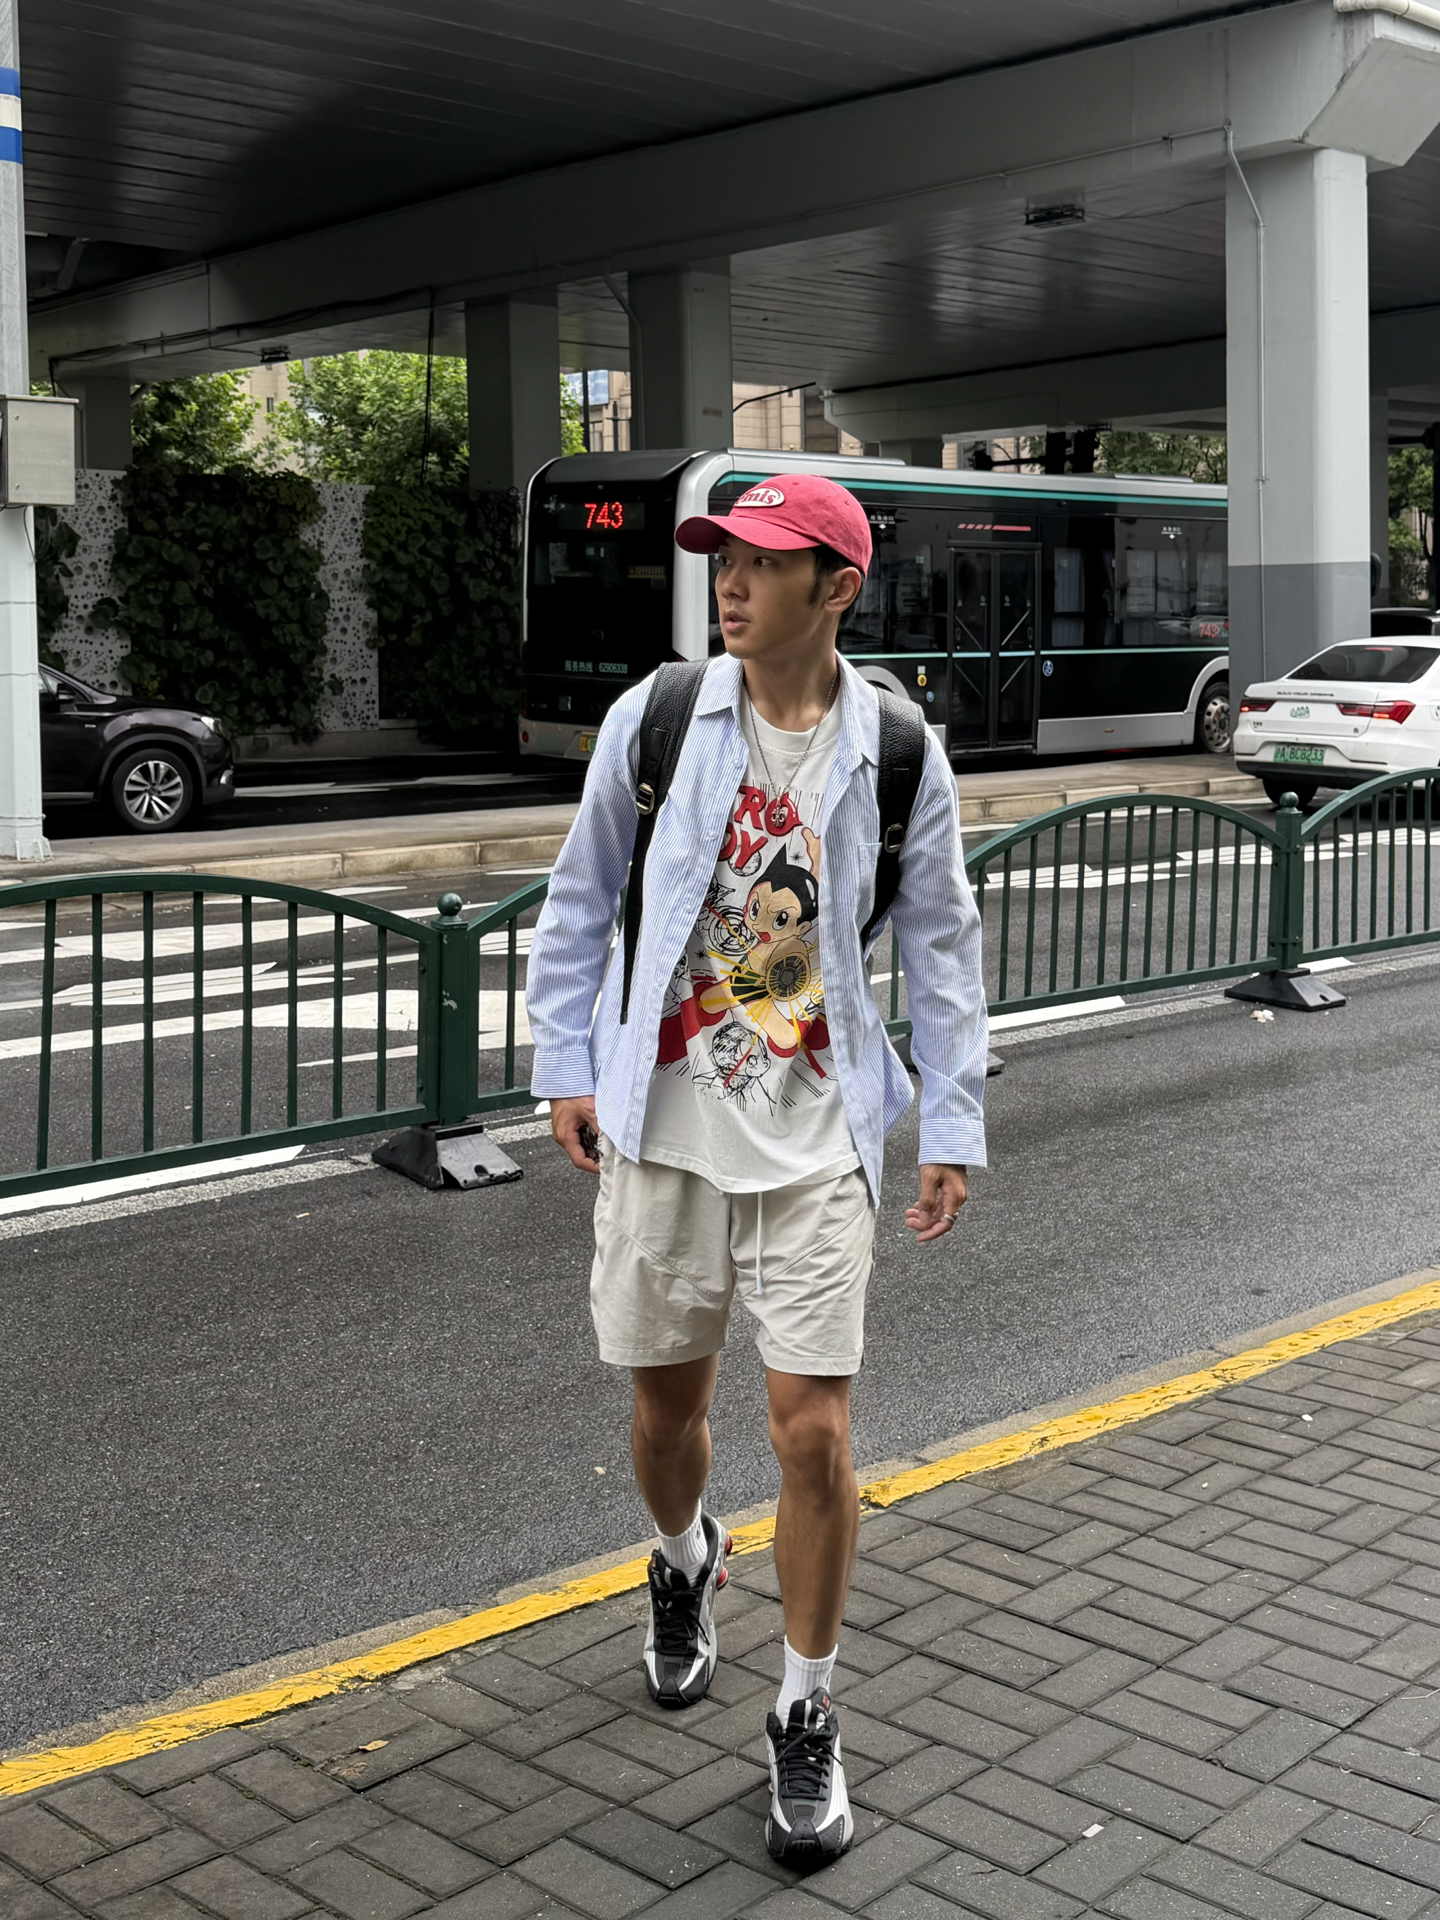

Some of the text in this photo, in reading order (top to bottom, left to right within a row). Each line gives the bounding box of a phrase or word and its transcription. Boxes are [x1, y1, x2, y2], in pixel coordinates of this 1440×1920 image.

[584, 502, 623, 528] 743
[734, 784, 803, 837] RO
[718, 822, 768, 870] OY
